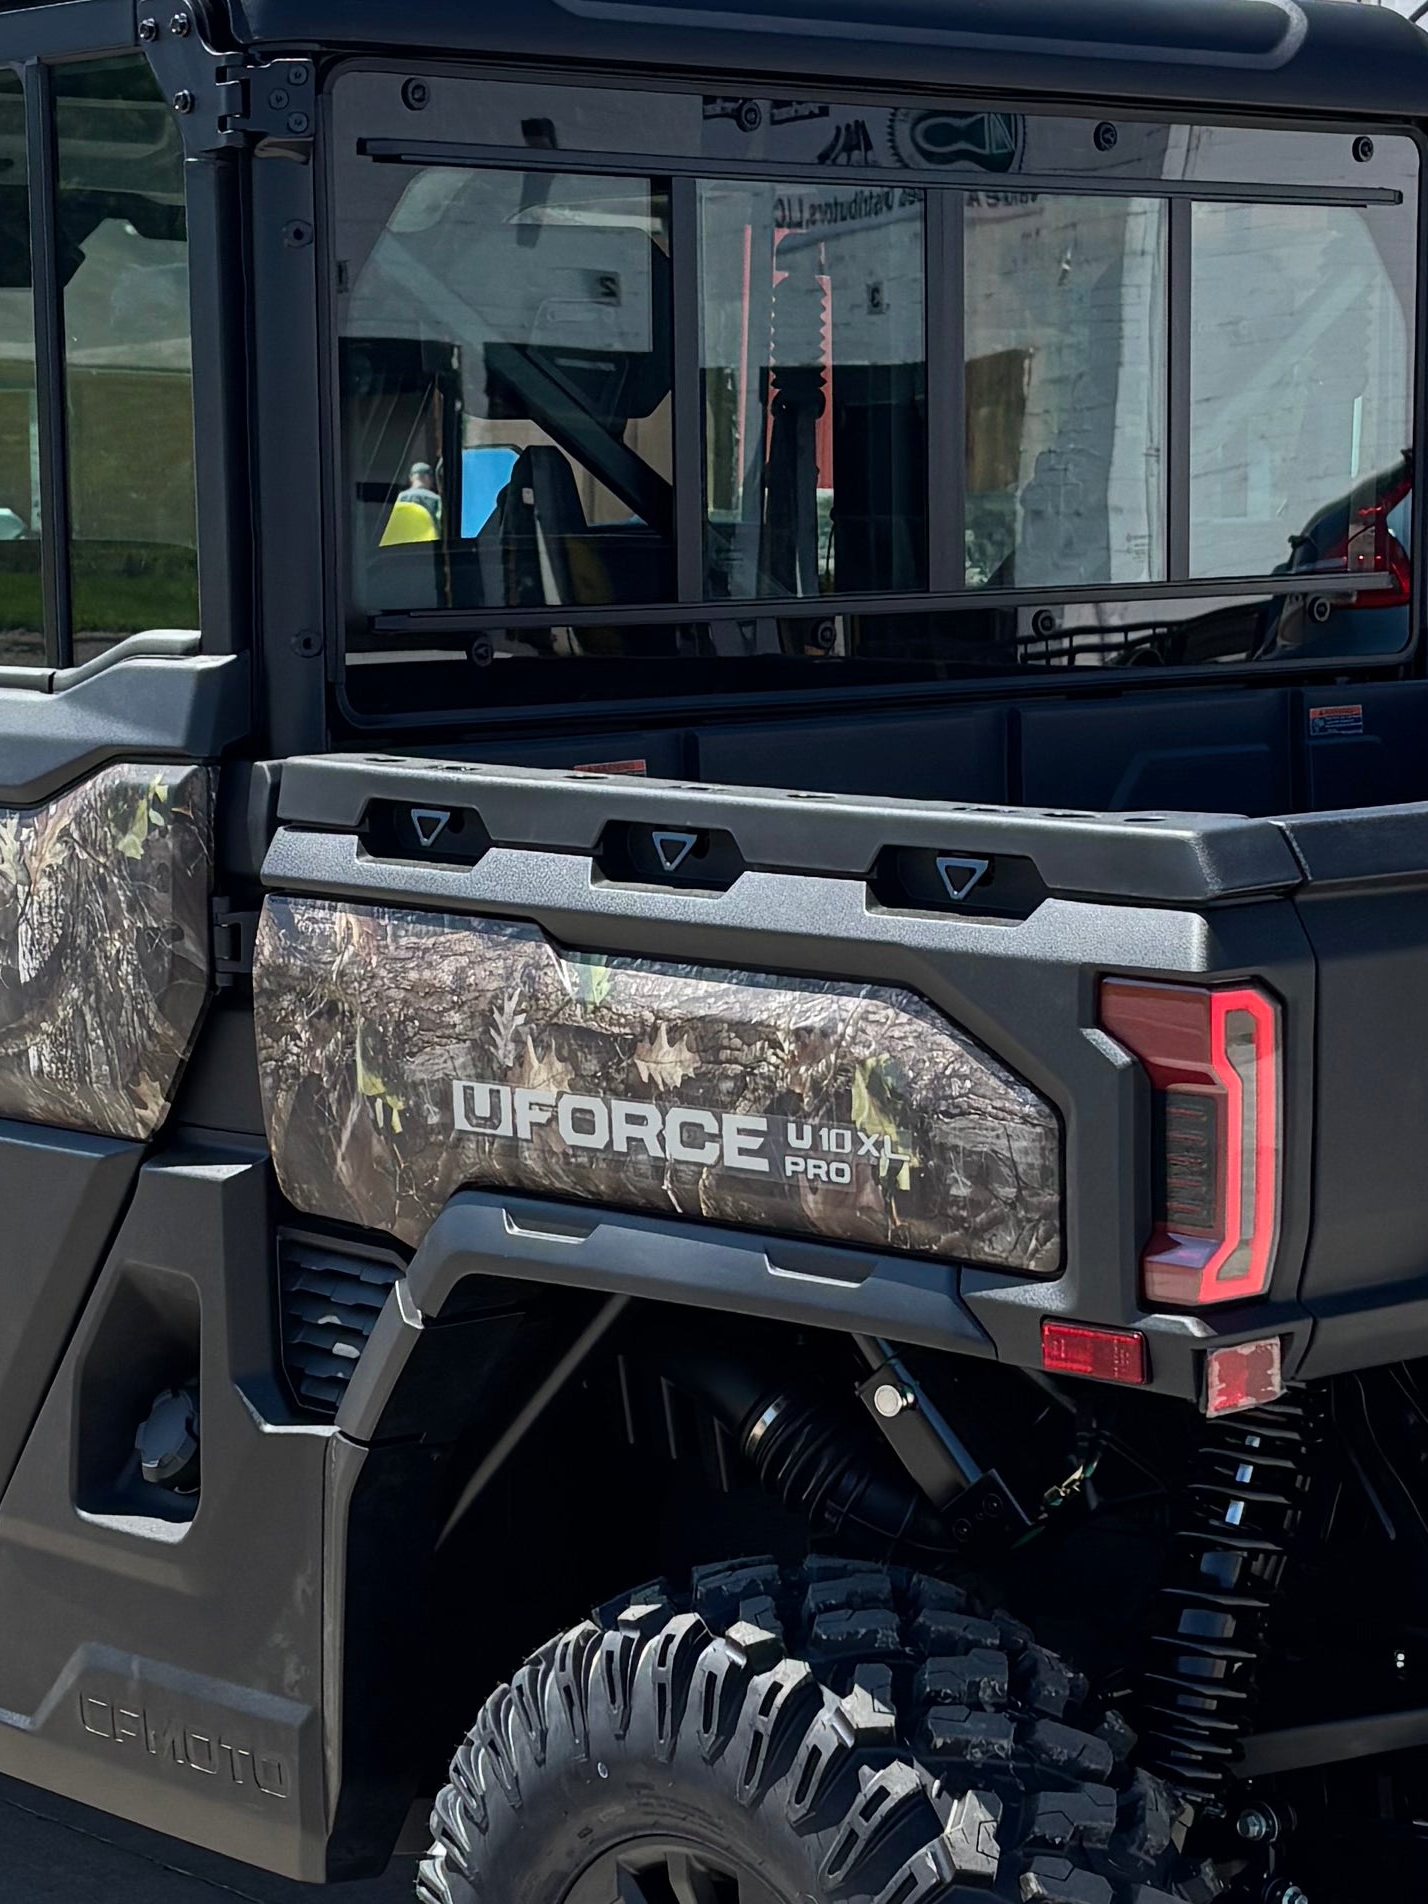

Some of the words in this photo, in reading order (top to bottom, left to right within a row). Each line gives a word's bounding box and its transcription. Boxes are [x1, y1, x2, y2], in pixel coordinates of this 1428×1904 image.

[452, 1079, 771, 1173] UFORCE
[784, 1154, 852, 1185] PRO
[79, 1691, 291, 1799] CFMOTO
